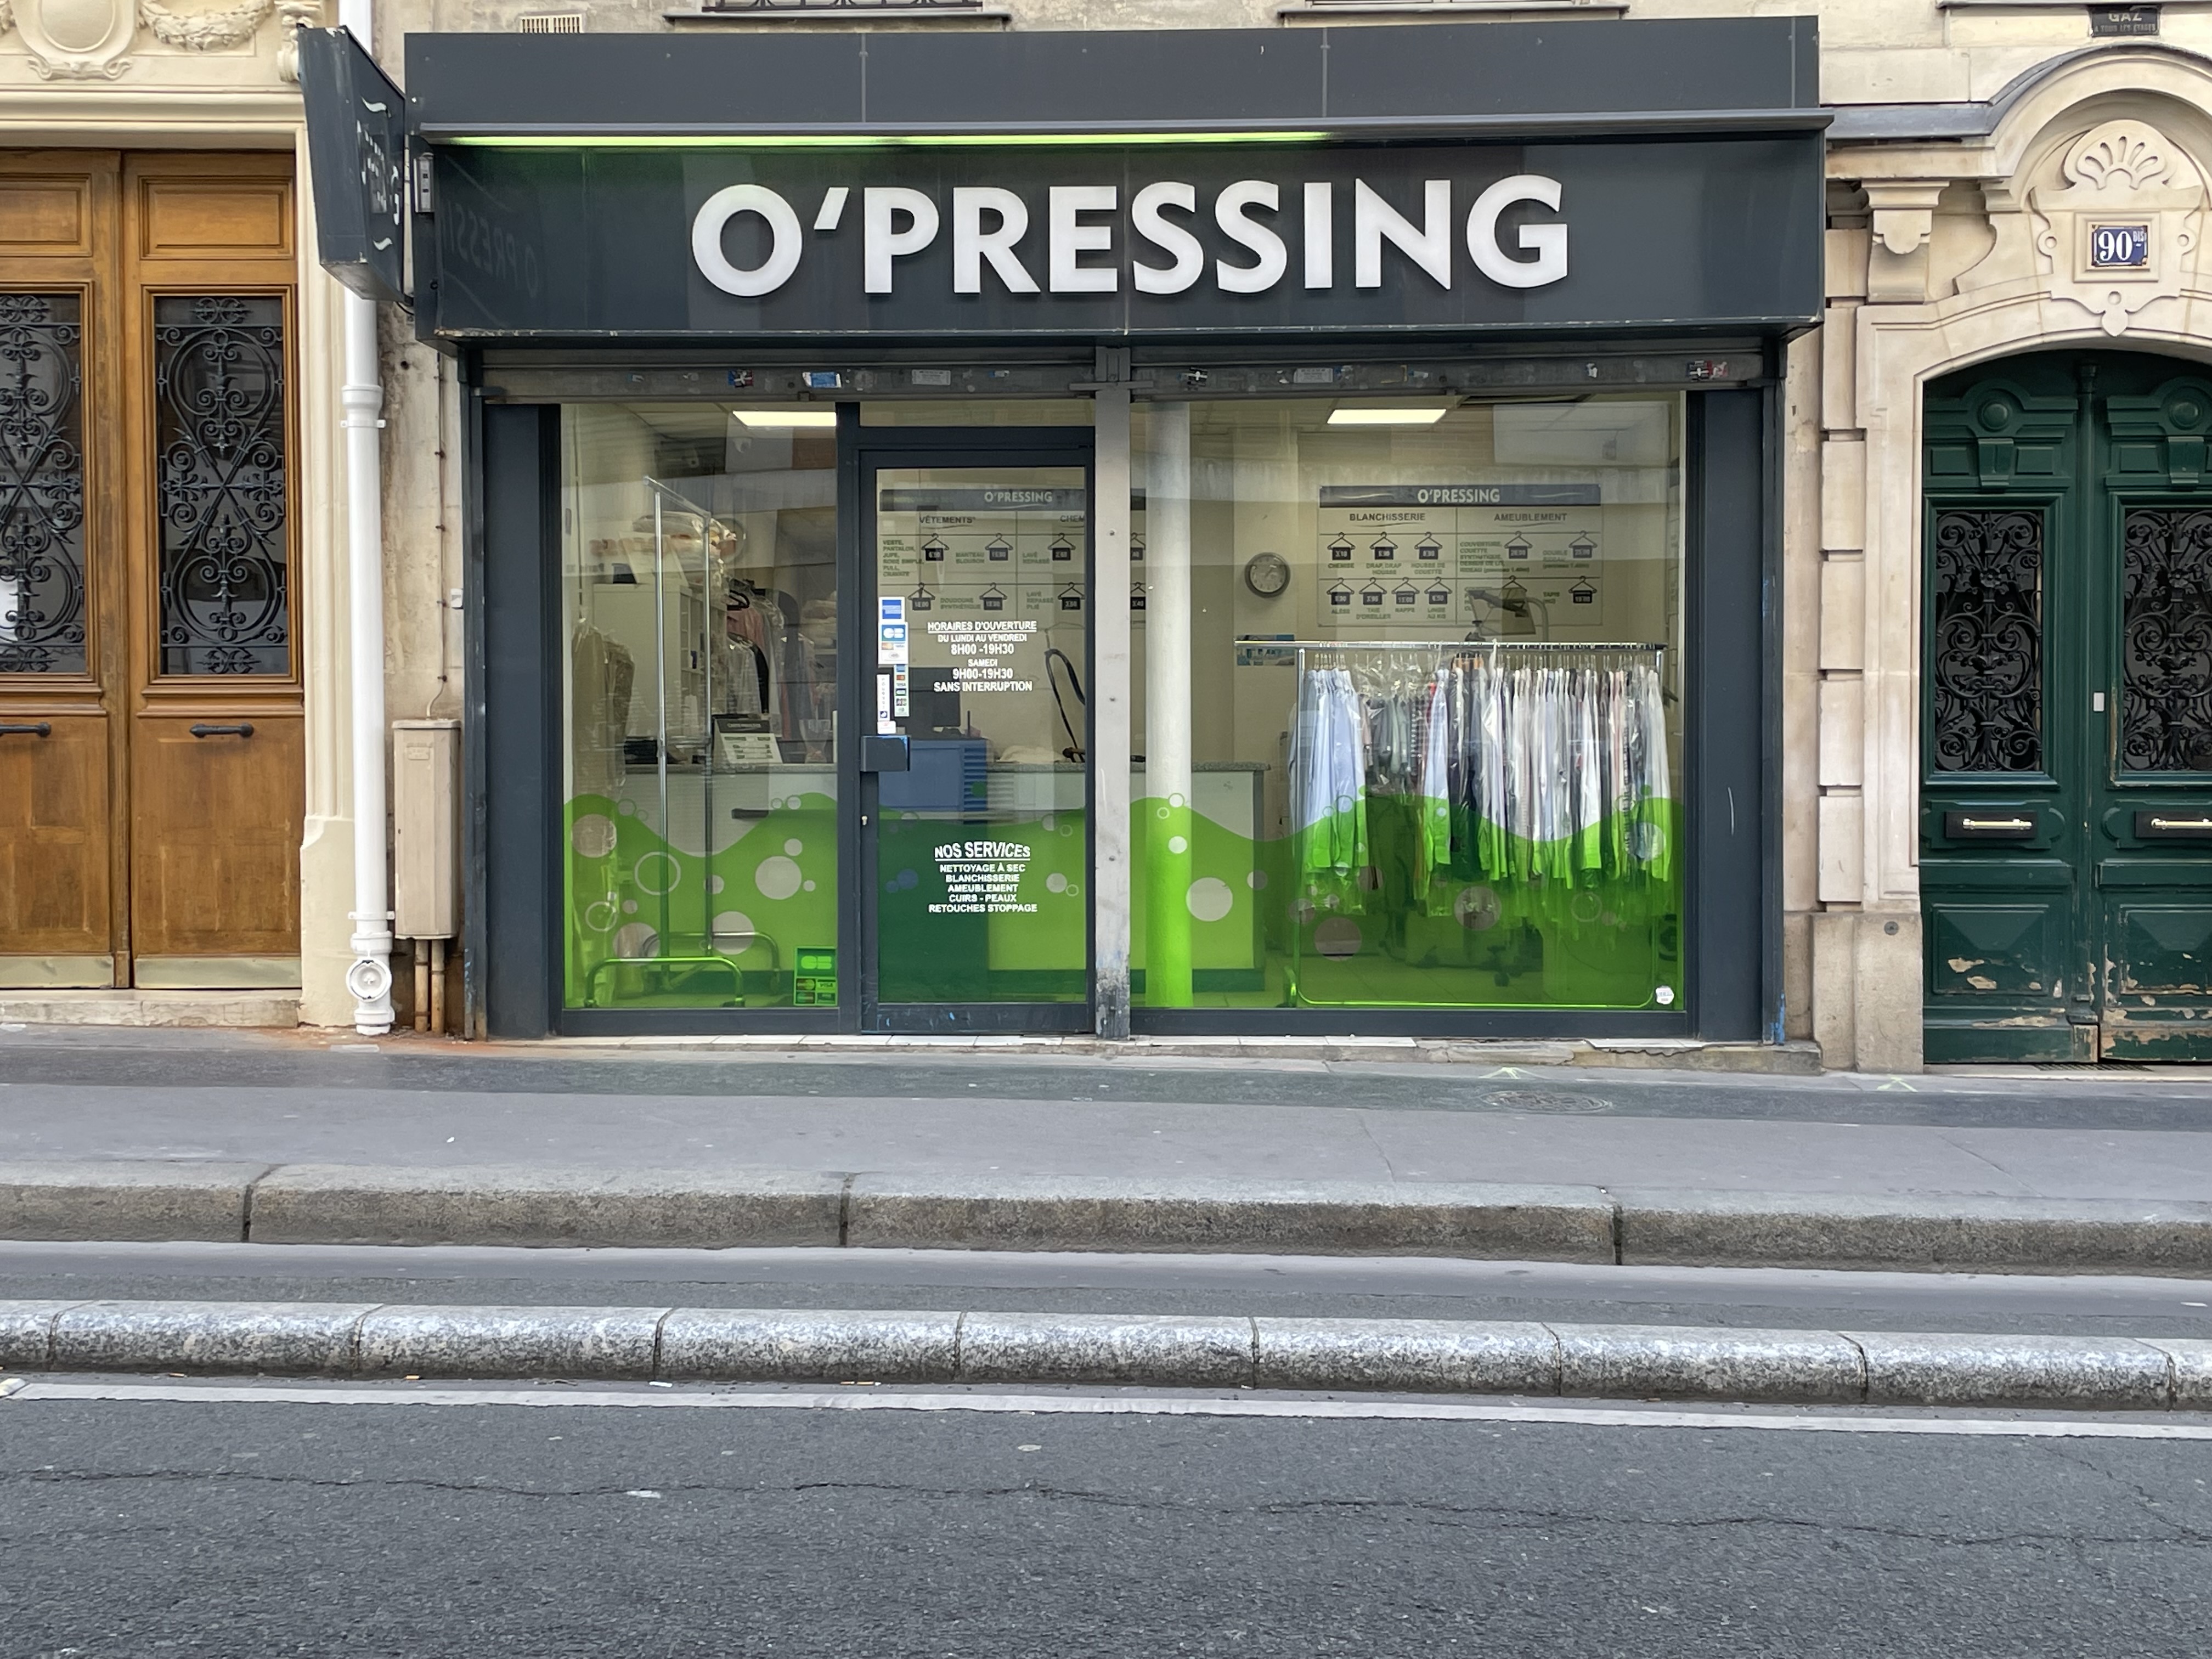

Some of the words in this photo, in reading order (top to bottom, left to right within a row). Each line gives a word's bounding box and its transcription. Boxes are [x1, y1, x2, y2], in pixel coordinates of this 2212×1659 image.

[2108, 12, 2142, 22] GAZ
[691, 174, 1568, 296] O'PRESSING
[2098, 231, 2132, 261] 90
[984, 491, 1052, 502] O'PRESSING
[1418, 489, 1500, 503] O'PRESSING
[1350, 512, 1425, 521] BLANCHISSERIE
[1494, 513, 1567, 521] AMEUBLEMENT
[928, 622, 973, 630] HORAIRES
[975, 620, 1037, 630] D'OUVERTURE
[988, 634, 1027, 642] VENDREDI
[951, 644, 977, 654] 8H00
[968, 659, 997, 667] SAMEDI
[934, 682, 960, 692] SANS
[962, 681, 1032, 692] INTERRUPTION
[935, 843, 962, 858] NOS
[964, 842, 1031, 857] SERVICES
[940, 864, 995, 872] NETTOYAGE
[1007, 864, 1026, 872] SEC
[946, 874, 1020, 882] BLANCHISSERIE
[948, 884, 1018, 892] AMEUBLEMENT
[929, 904, 985, 912] RETOUCHES
